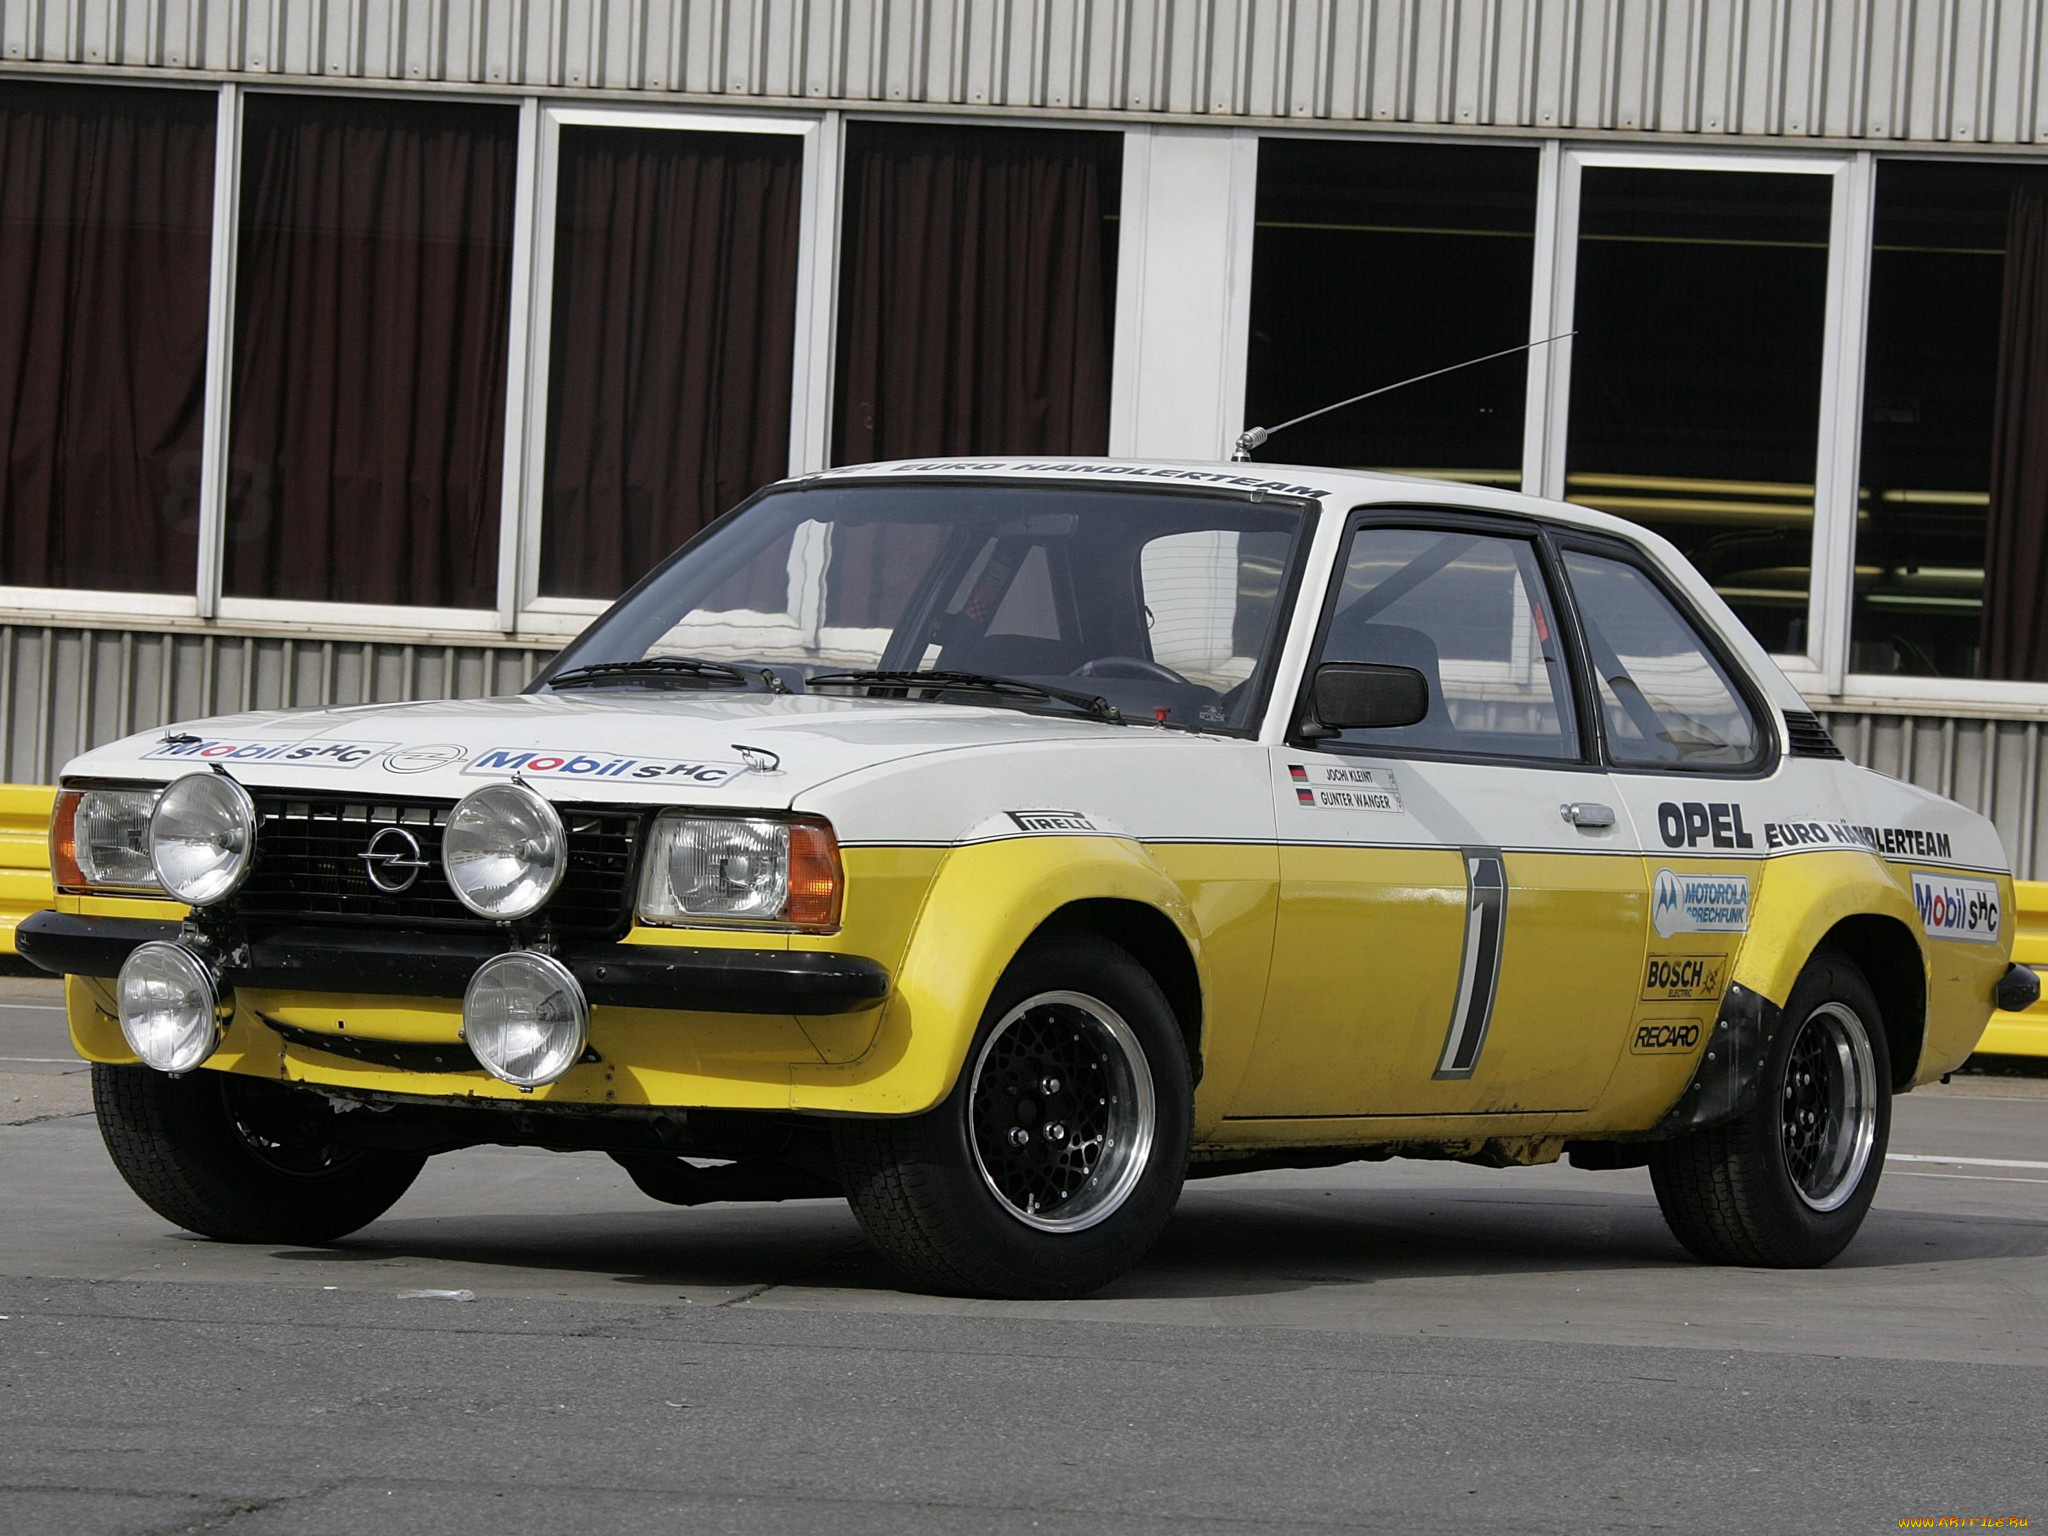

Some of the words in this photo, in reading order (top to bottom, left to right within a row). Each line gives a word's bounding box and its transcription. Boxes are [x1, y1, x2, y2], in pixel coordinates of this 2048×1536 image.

[891, 463, 1007, 472] EURO
[286, 744, 371, 763] SHC
[475, 751, 638, 777] Mobil
[631, 764, 729, 782] SHC
[1348, 770, 1373, 784] KLEINT
[1320, 791, 1354, 807] GUNTER
[1353, 793, 1392, 810] WANGER
[1002, 809, 1097, 832] PIRELLI
[1657, 801, 1753, 849] OPEL
[1764, 822, 1830, 849] EURO
[1826, 818, 1952, 859] HÄNDLERTEAM
[1684, 882, 1747, 905] MOTOROLA
[1914, 882, 1966, 930] Mobil
[1968, 891, 1998, 932] SHC
[1440, 858, 1503, 1071] 1
[1646, 960, 1704, 989] BOSCH
[1634, 1025, 1700, 1048] RECARO
